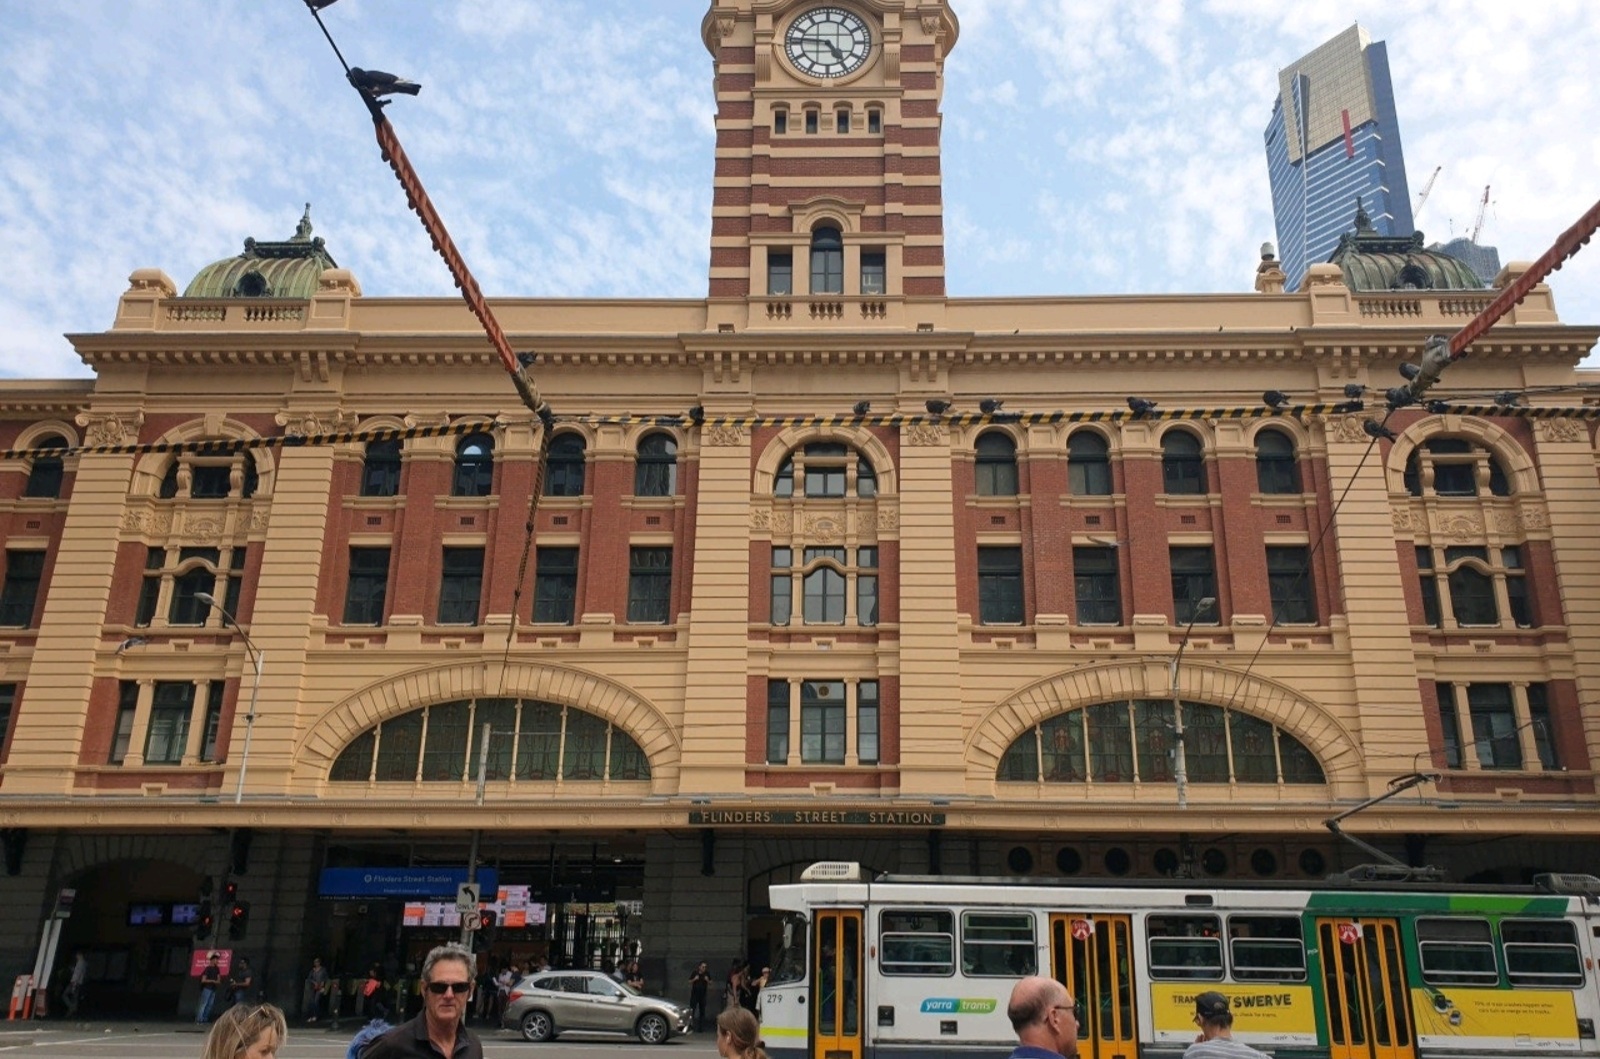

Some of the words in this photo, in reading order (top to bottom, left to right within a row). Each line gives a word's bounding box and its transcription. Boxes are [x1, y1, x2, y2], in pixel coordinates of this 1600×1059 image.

[701, 810, 771, 823] FLINDERS
[795, 811, 847, 823] STREET
[869, 812, 933, 824] STATION
[373, 874, 402, 883] Flinders
[403, 874, 425, 883] Street
[427, 874, 452, 883] Station
[767, 994, 783, 1003] 279
[1233, 993, 1292, 1008] SWERVE
[926, 1001, 952, 1011] yarra
[962, 1001, 991, 1010] trams
